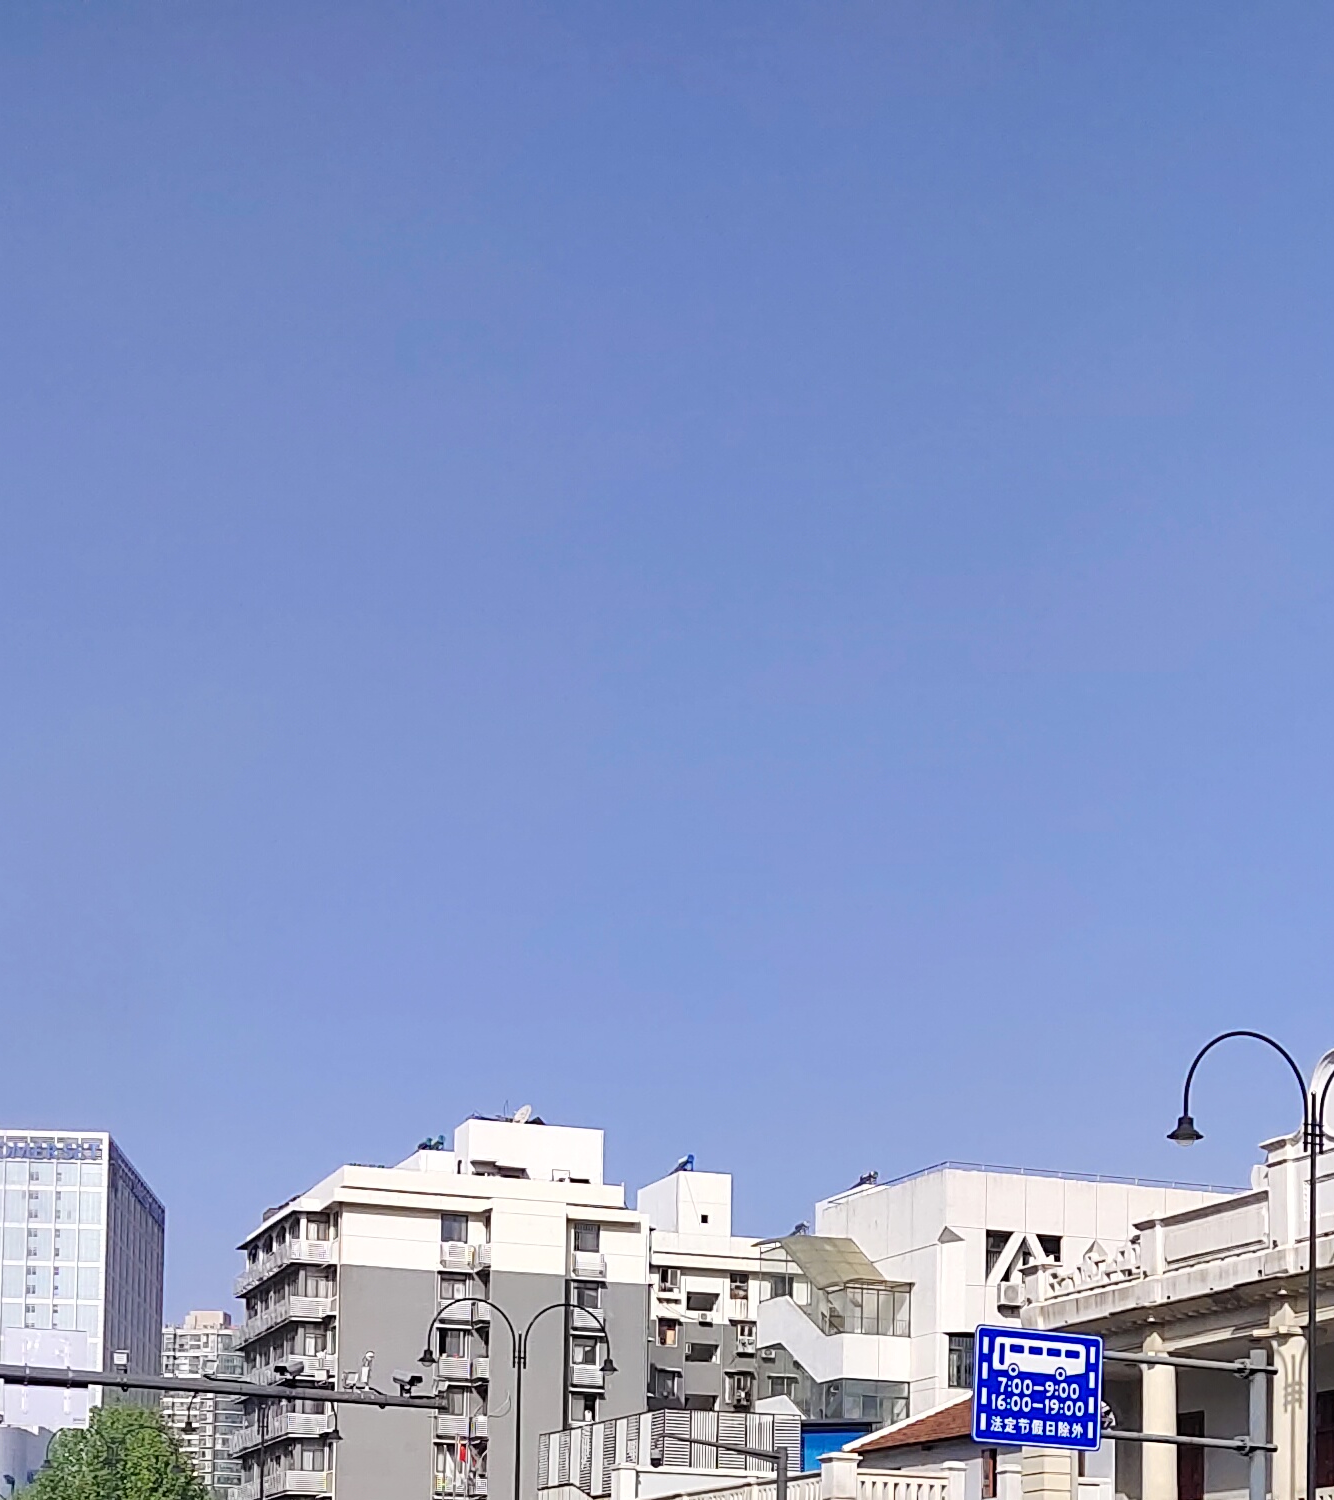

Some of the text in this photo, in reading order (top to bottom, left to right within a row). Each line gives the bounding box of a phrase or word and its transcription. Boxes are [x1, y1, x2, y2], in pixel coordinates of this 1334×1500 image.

[990, 1415, 1084, 1439] 法定节假日除外
